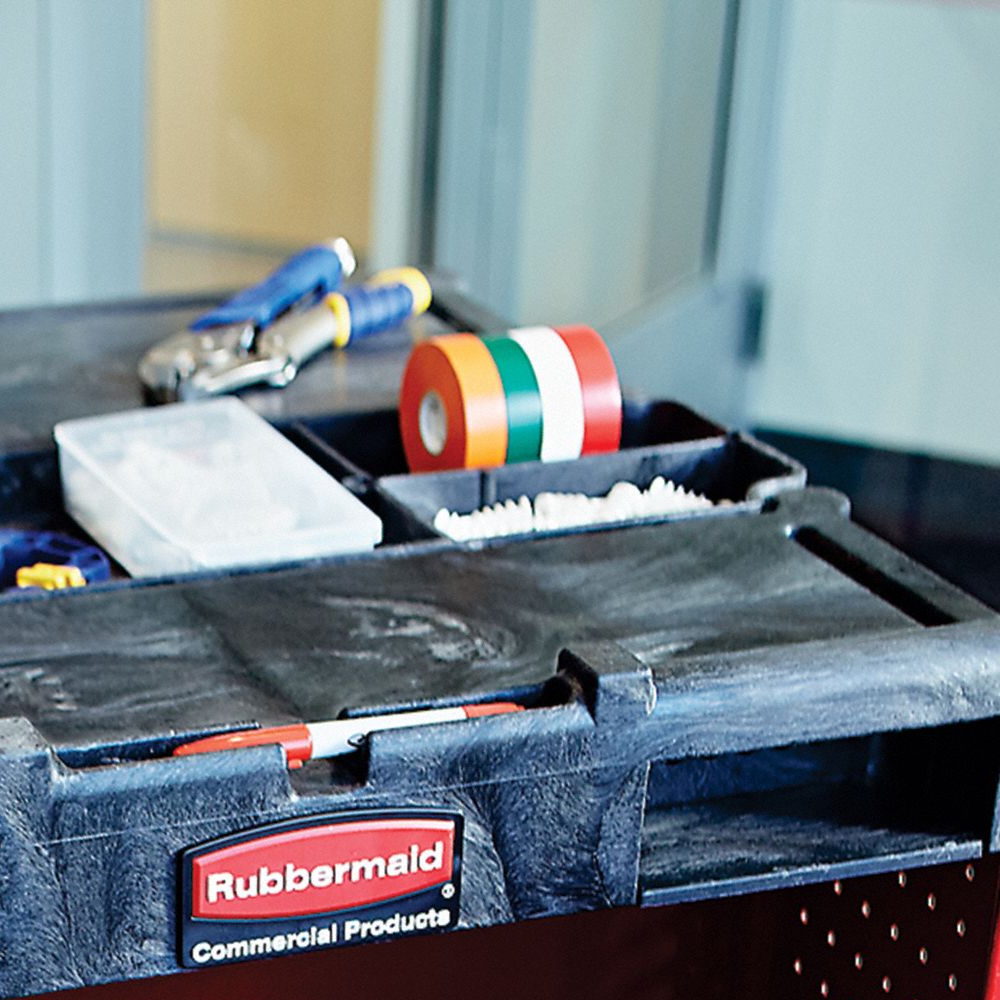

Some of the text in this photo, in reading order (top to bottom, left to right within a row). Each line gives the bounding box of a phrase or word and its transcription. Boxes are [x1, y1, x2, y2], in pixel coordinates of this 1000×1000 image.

[206, 841, 445, 903] Rubbermaid
[191, 908, 451, 963] Commercial Products
